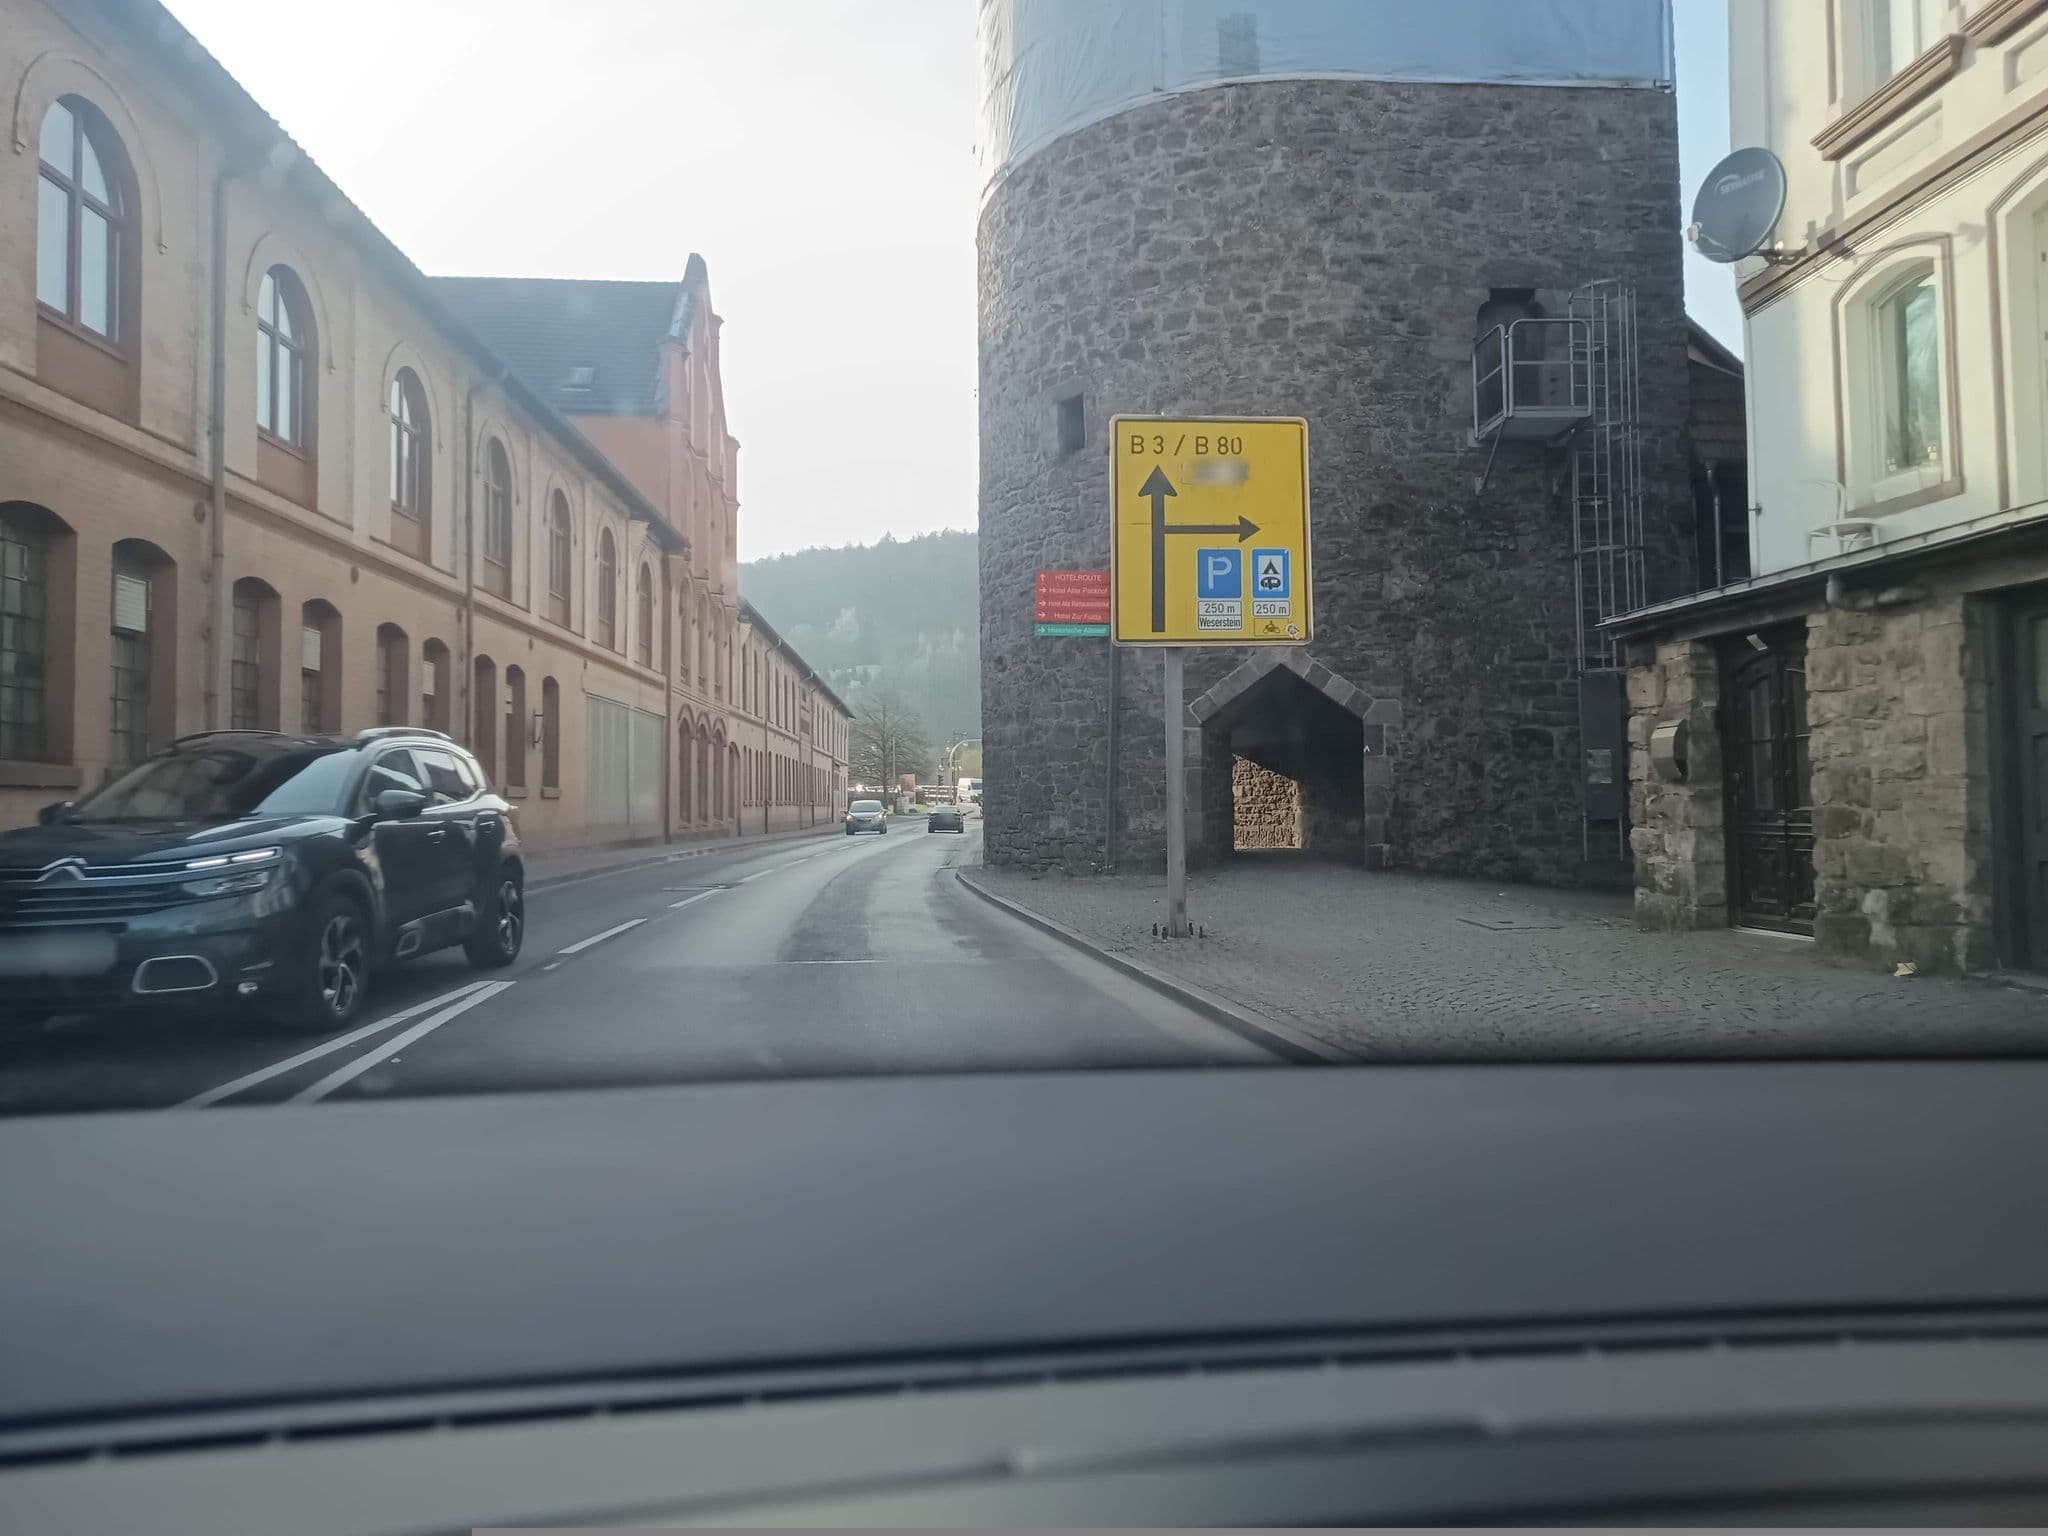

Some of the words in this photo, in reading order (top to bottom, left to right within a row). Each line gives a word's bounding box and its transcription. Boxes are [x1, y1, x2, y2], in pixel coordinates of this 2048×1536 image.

[1131, 435, 1145, 454] B
[1153, 435, 1164, 454] 3
[1174, 434, 1186, 456] /
[1195, 436, 1209, 455] B
[1217, 436, 1242, 455] 80
[1208, 556, 1233, 590] P
[1204, 603, 1225, 613] 250
[1227, 605, 1235, 613] m
[1256, 604, 1276, 614] 250
[1278, 606, 1287, 614] m
[1199, 617, 1241, 628] Weserstein
